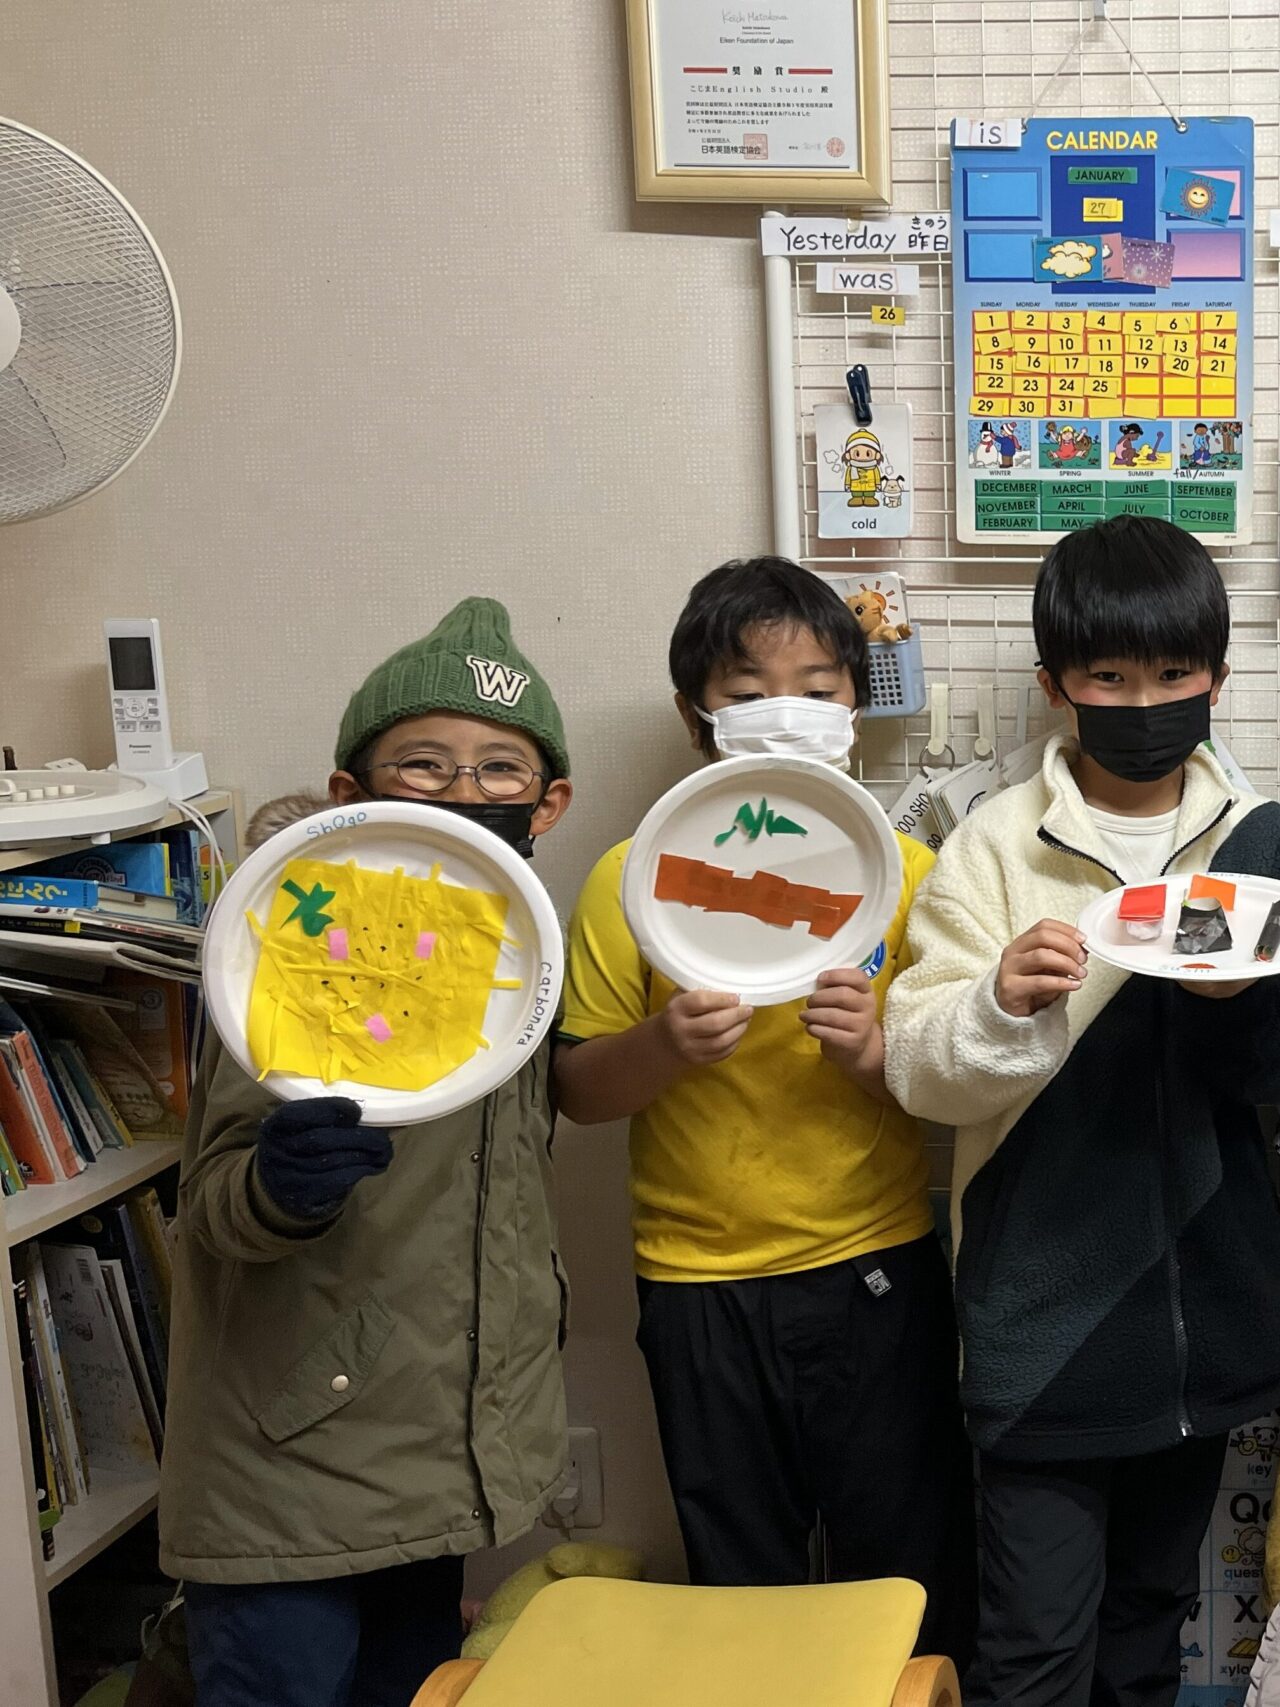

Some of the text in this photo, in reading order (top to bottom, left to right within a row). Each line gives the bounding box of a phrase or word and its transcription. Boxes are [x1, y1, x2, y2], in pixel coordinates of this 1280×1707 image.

[771, 86, 813, 94] Studio
[979, 122, 1002, 145] is
[1046, 130, 1158, 150] CALENDAR
[1075, 170, 1125, 182] JANUARY
[1090, 202, 1106, 215] 27
[911, 216, 947, 230] きのう
[780, 225, 949, 253] Yesterday 昨日
[839, 272, 894, 291] was
[880, 308, 896, 320] 26
[989, 314, 1223, 332] 1 2 3 4 5 6 7
[991, 336, 1227, 353] 8 9 10 11 12 13 14
[990, 355, 1225, 373] 15 16 17 18 19 20 21
[988, 376, 1108, 393] 22 23 24 25
[978, 399, 1073, 413] 29 30 31
[982, 483, 1233, 497] DECEMBER MARCH JUNE SEPTEMBER
[977, 501, 1229, 522] NOVEMBER APRIL JULY OCTOBER
[851, 518, 877, 530] cold
[983, 518, 1084, 528] FEBRUARY MAY
[466, 655, 530, 707] W
[909, 793, 929, 817] SHO
[1232, 1594, 1268, 1624] X
[1219, 1663, 1251, 1677] xylo
